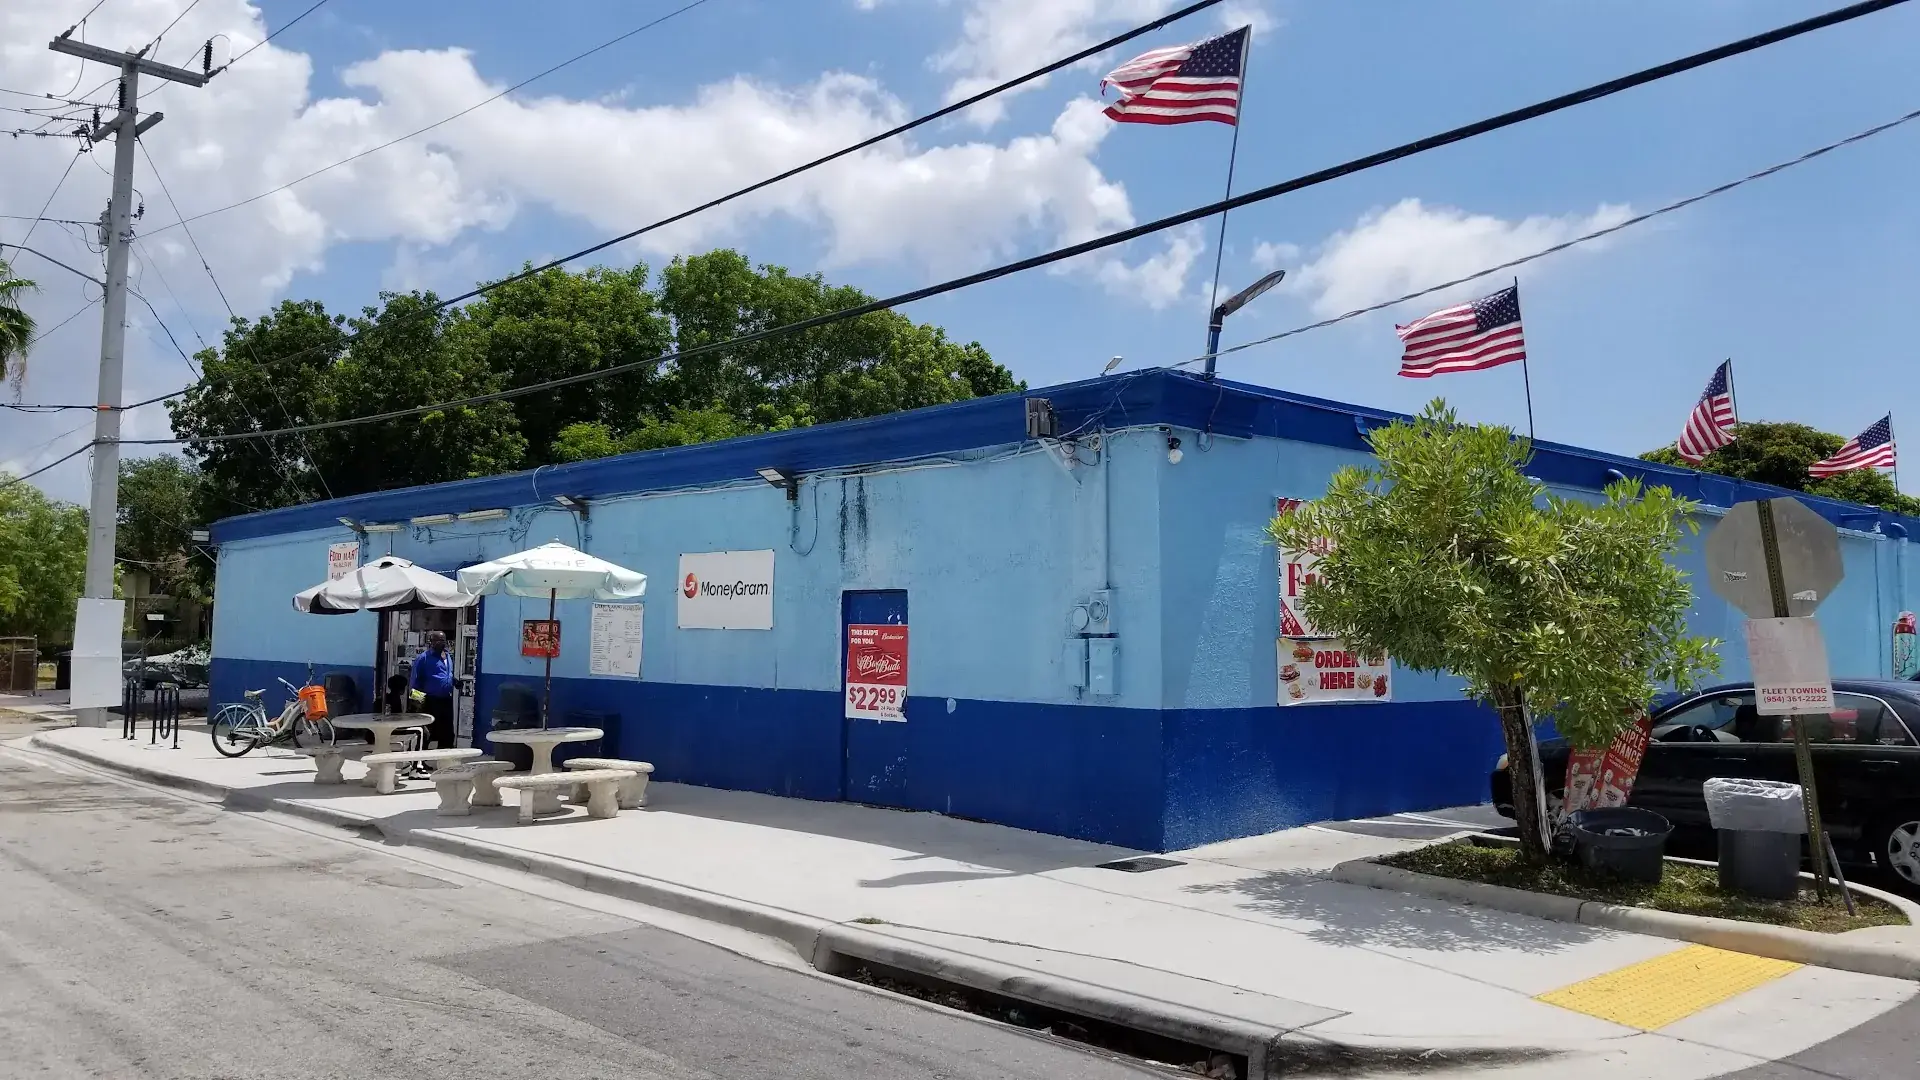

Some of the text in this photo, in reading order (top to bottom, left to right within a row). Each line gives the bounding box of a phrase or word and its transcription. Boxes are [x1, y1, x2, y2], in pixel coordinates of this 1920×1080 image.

[701, 580, 768, 600] MoneyGram
[1315, 650, 1360, 668] ORDER
[1319, 672, 1355, 689] HERE
[1762, 687, 1827, 695] FLEET TOWING
[1764, 695, 1785, 703] (954)
[1610, 737, 1641, 766] CHANCE
